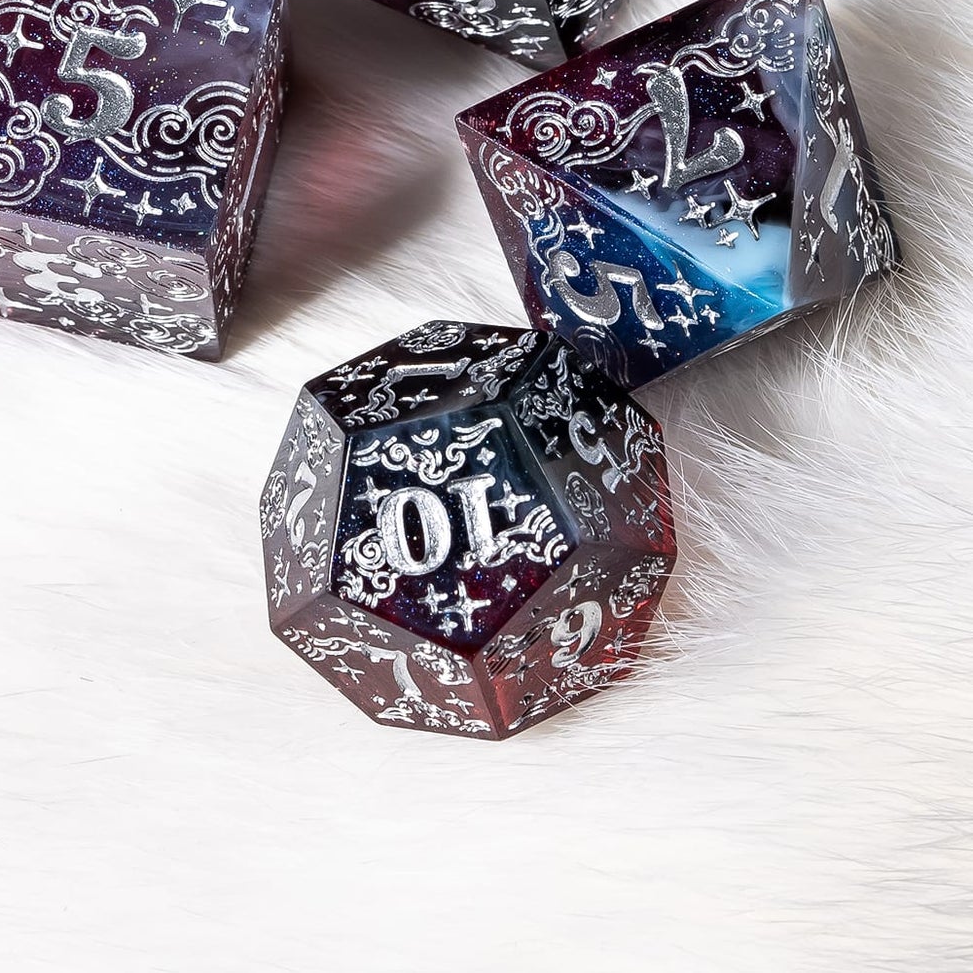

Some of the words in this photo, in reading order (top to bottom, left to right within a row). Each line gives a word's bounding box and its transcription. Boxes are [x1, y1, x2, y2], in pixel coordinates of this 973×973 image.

[40, 27, 147, 140] 5
[645, 66, 745, 189] 7
[551, 251, 665, 331] 5
[386, 358, 471, 383] 1
[568, 411, 630, 493] 5
[286, 461, 317, 549] 2
[376, 473, 497, 576] 10
[363, 646, 422, 699] 7
